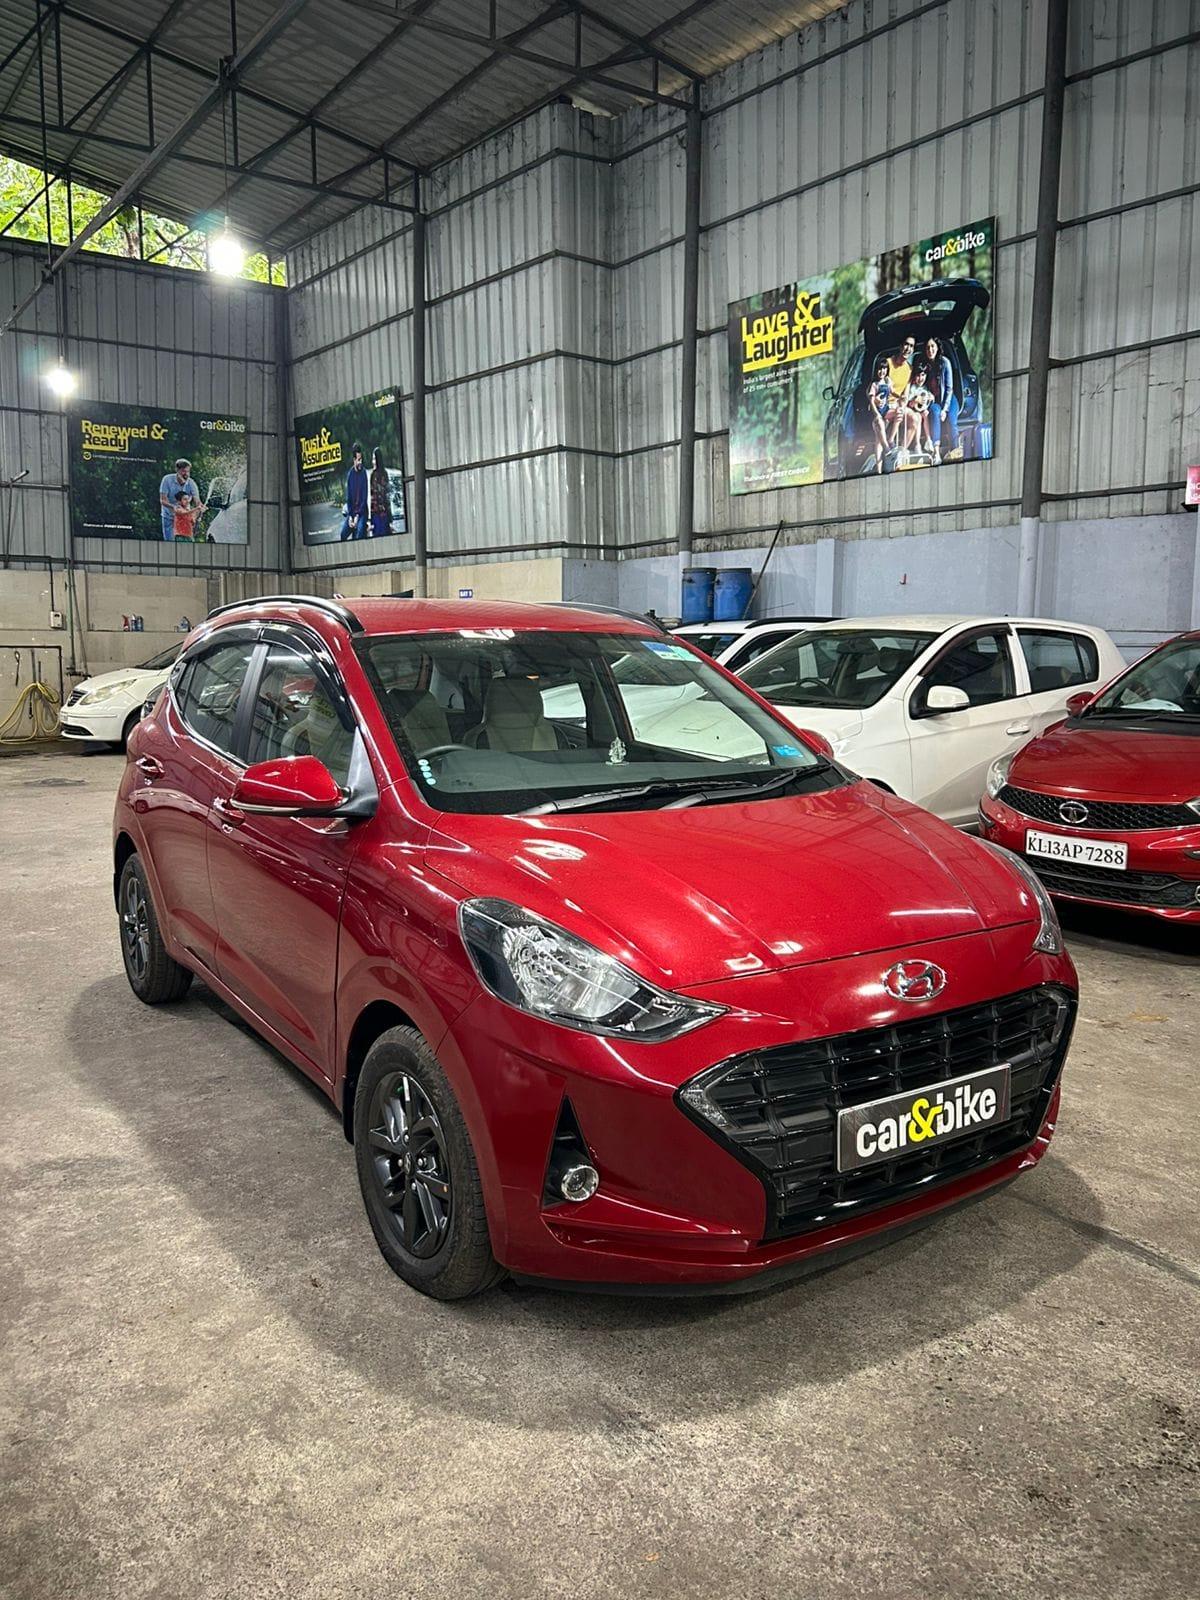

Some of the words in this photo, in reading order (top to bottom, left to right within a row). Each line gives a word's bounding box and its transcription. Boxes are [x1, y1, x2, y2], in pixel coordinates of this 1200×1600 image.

[926, 232, 985, 262] car&bike
[741, 310, 788, 342] Love
[794, 291, 820, 326] &
[743, 323, 832, 363] Laughter
[759, 372, 775, 382] largest
[82, 420, 148, 439] Renewed
[151, 424, 168, 440] &
[200, 420, 245, 433] car&bike
[84, 432, 127, 450] Ready
[300, 434, 320, 452] Trust
[321, 427, 331, 446] &
[302, 447, 341, 466] Assurance
[1028, 837, 1083, 859] KL13AP
[1086, 846, 1124, 865] 7288
[856, 1085, 996, 1158] car&bike
